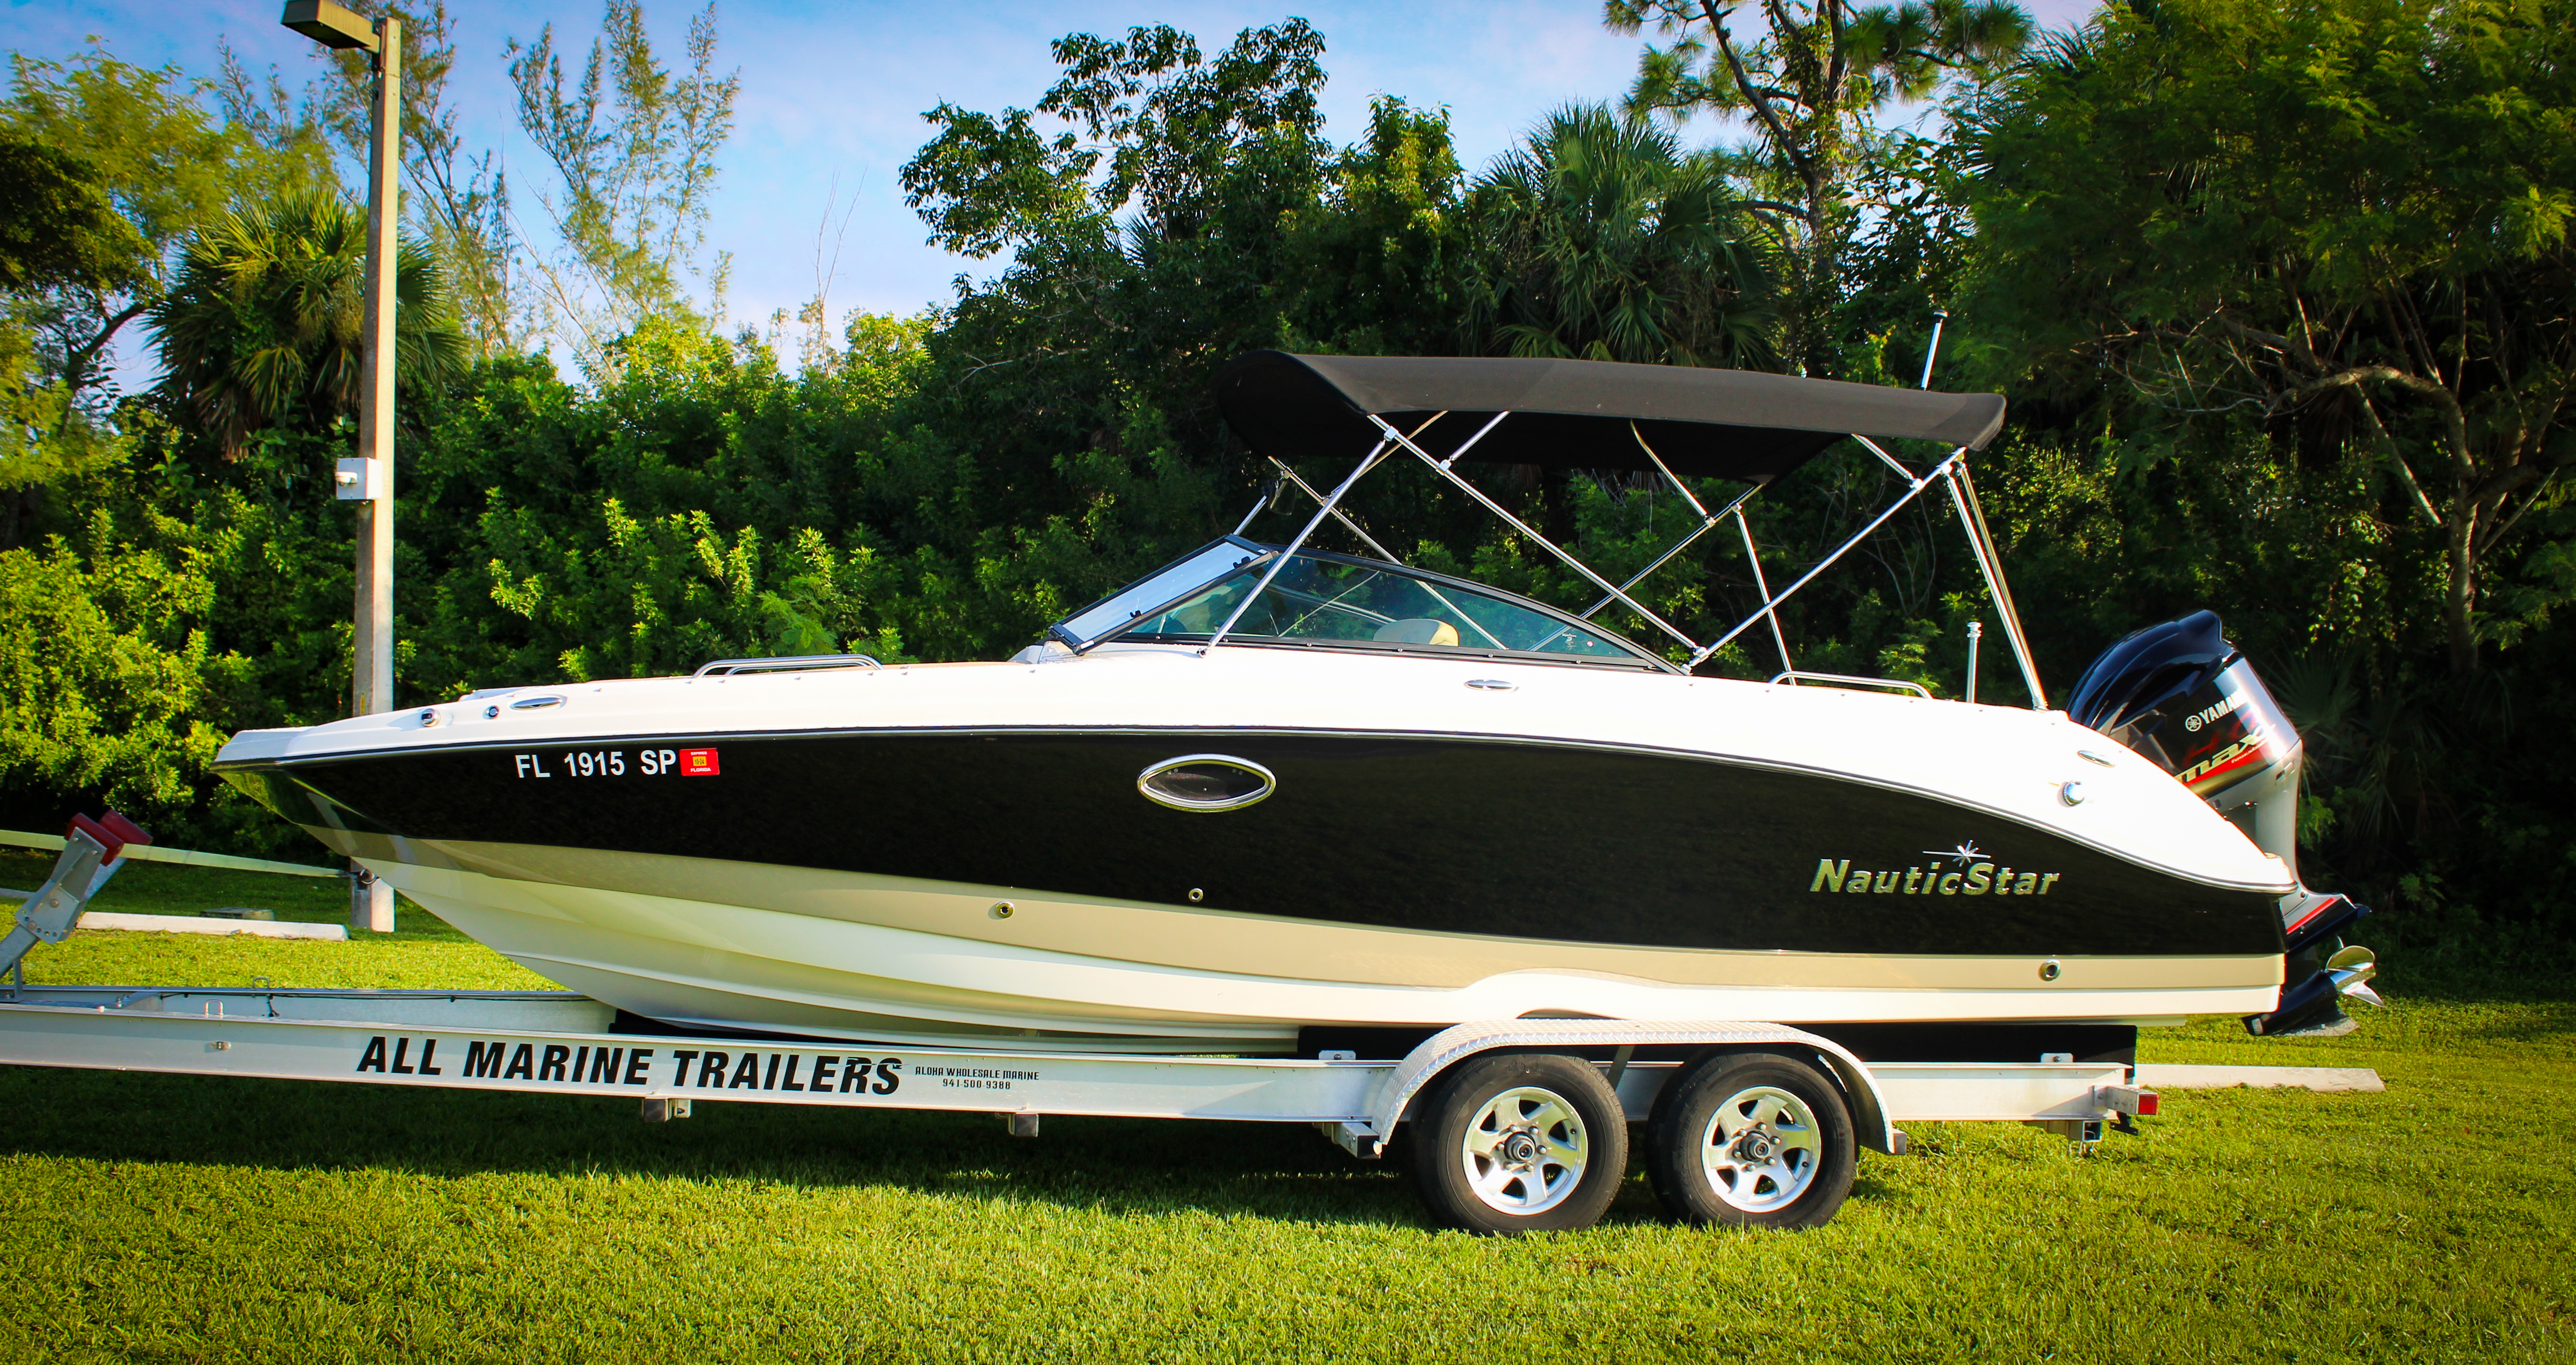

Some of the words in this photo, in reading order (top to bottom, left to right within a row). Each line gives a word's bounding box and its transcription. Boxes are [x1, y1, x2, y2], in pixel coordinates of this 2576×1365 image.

[515, 754, 551, 778] FL
[564, 751, 625, 776] 1915
[640, 749, 676, 775] SP
[1809, 858, 2060, 895] NauticStar
[356, 1036, 442, 1075] ALL
[462, 1041, 654, 1085] MARINE
[673, 1050, 903, 1095] TRAILERS
[915, 1066, 944, 1076] ALOHA
[946, 1067, 1001, 1078] WHOLESALE
[1003, 1070, 1040, 1080] MARINE
[942, 1078, 1010, 1089] 941-500-9388
